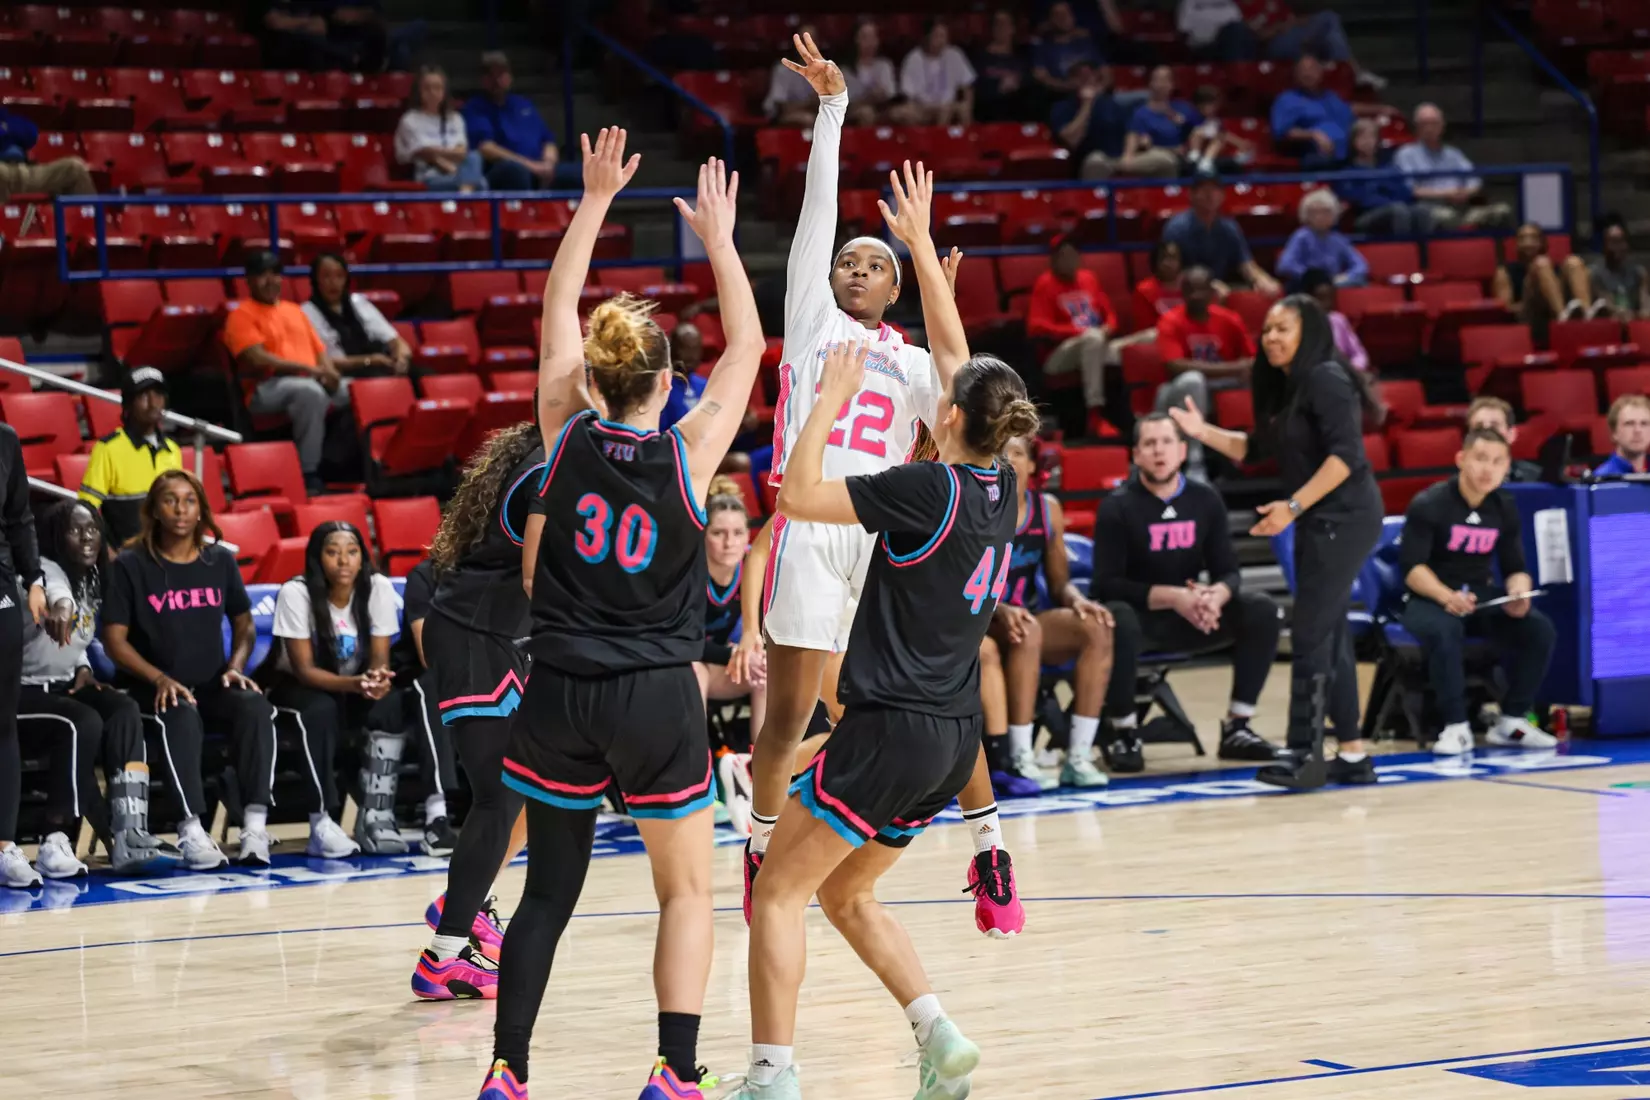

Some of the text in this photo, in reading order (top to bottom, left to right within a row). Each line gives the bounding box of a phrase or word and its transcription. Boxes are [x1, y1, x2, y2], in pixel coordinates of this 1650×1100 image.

[602, 440, 636, 463] FIU
[574, 492, 659, 574] 30
[1148, 520, 1196, 551] FIU
[1447, 524, 1499, 555] FIU
[963, 541, 1014, 615] 44
